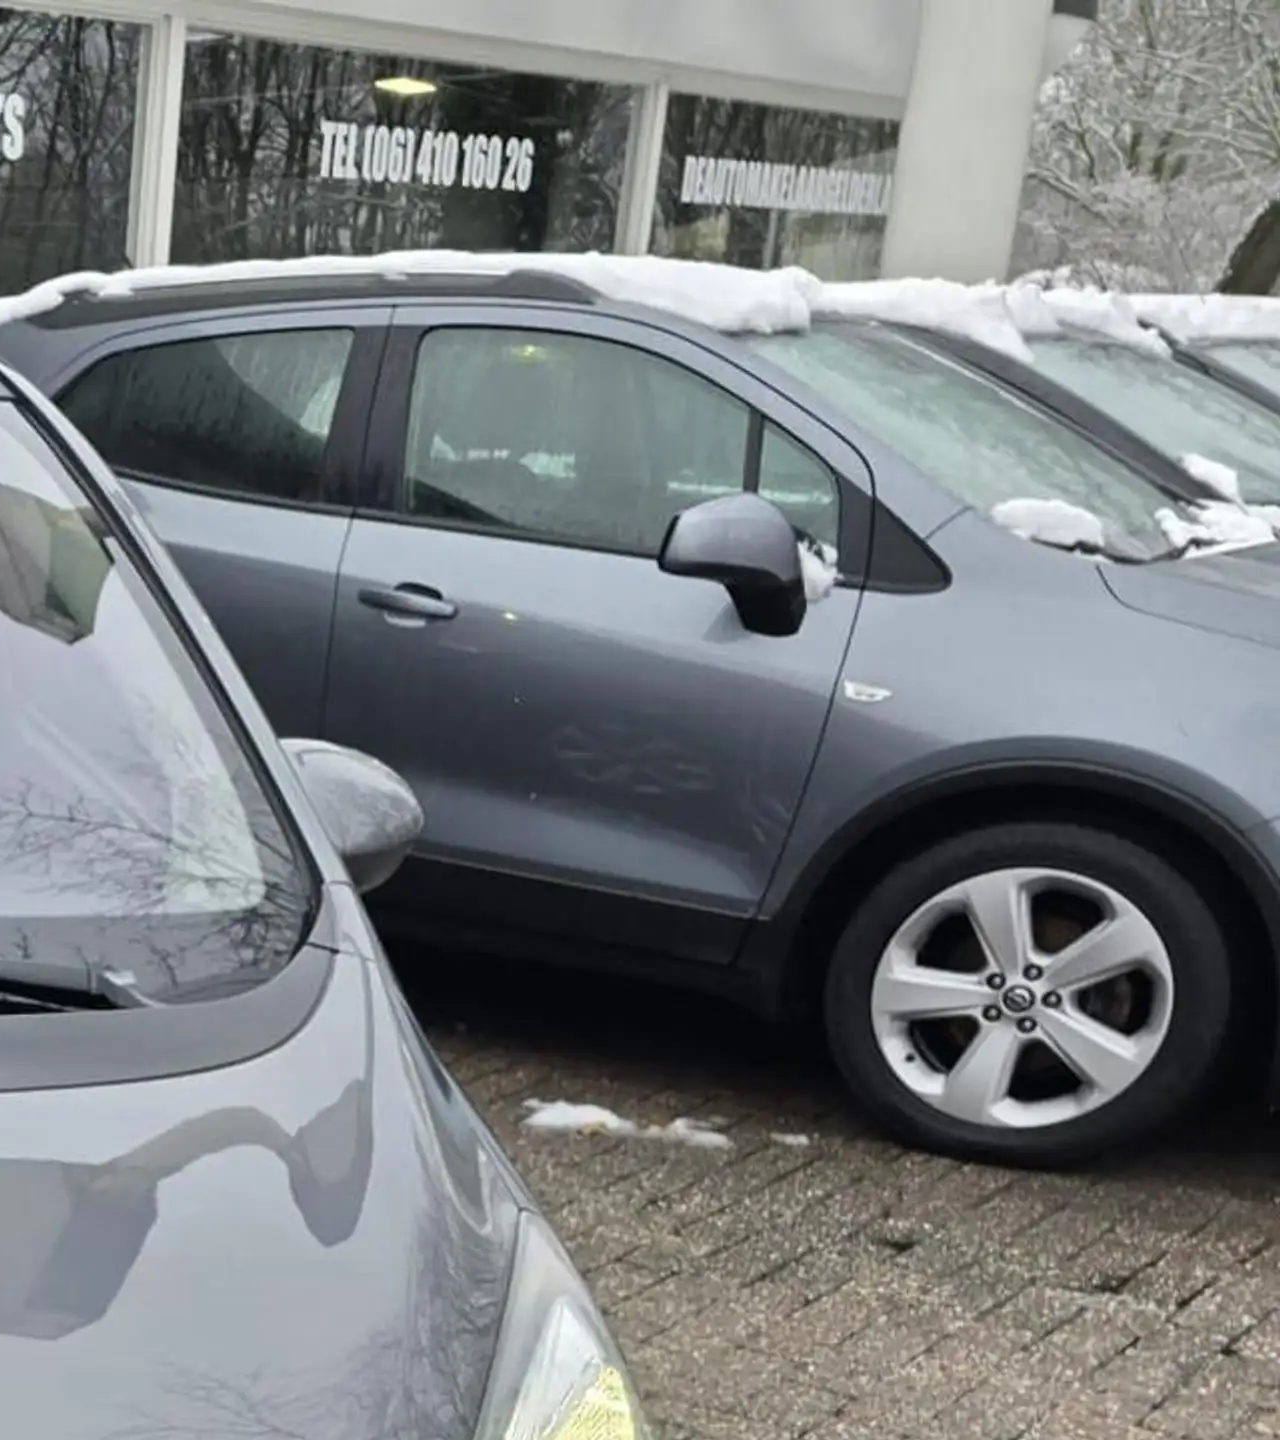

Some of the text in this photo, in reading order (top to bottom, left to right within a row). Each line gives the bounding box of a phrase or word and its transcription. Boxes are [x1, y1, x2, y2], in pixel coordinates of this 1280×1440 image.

[320, 118, 536, 192] TEL (06) 410 160 26
